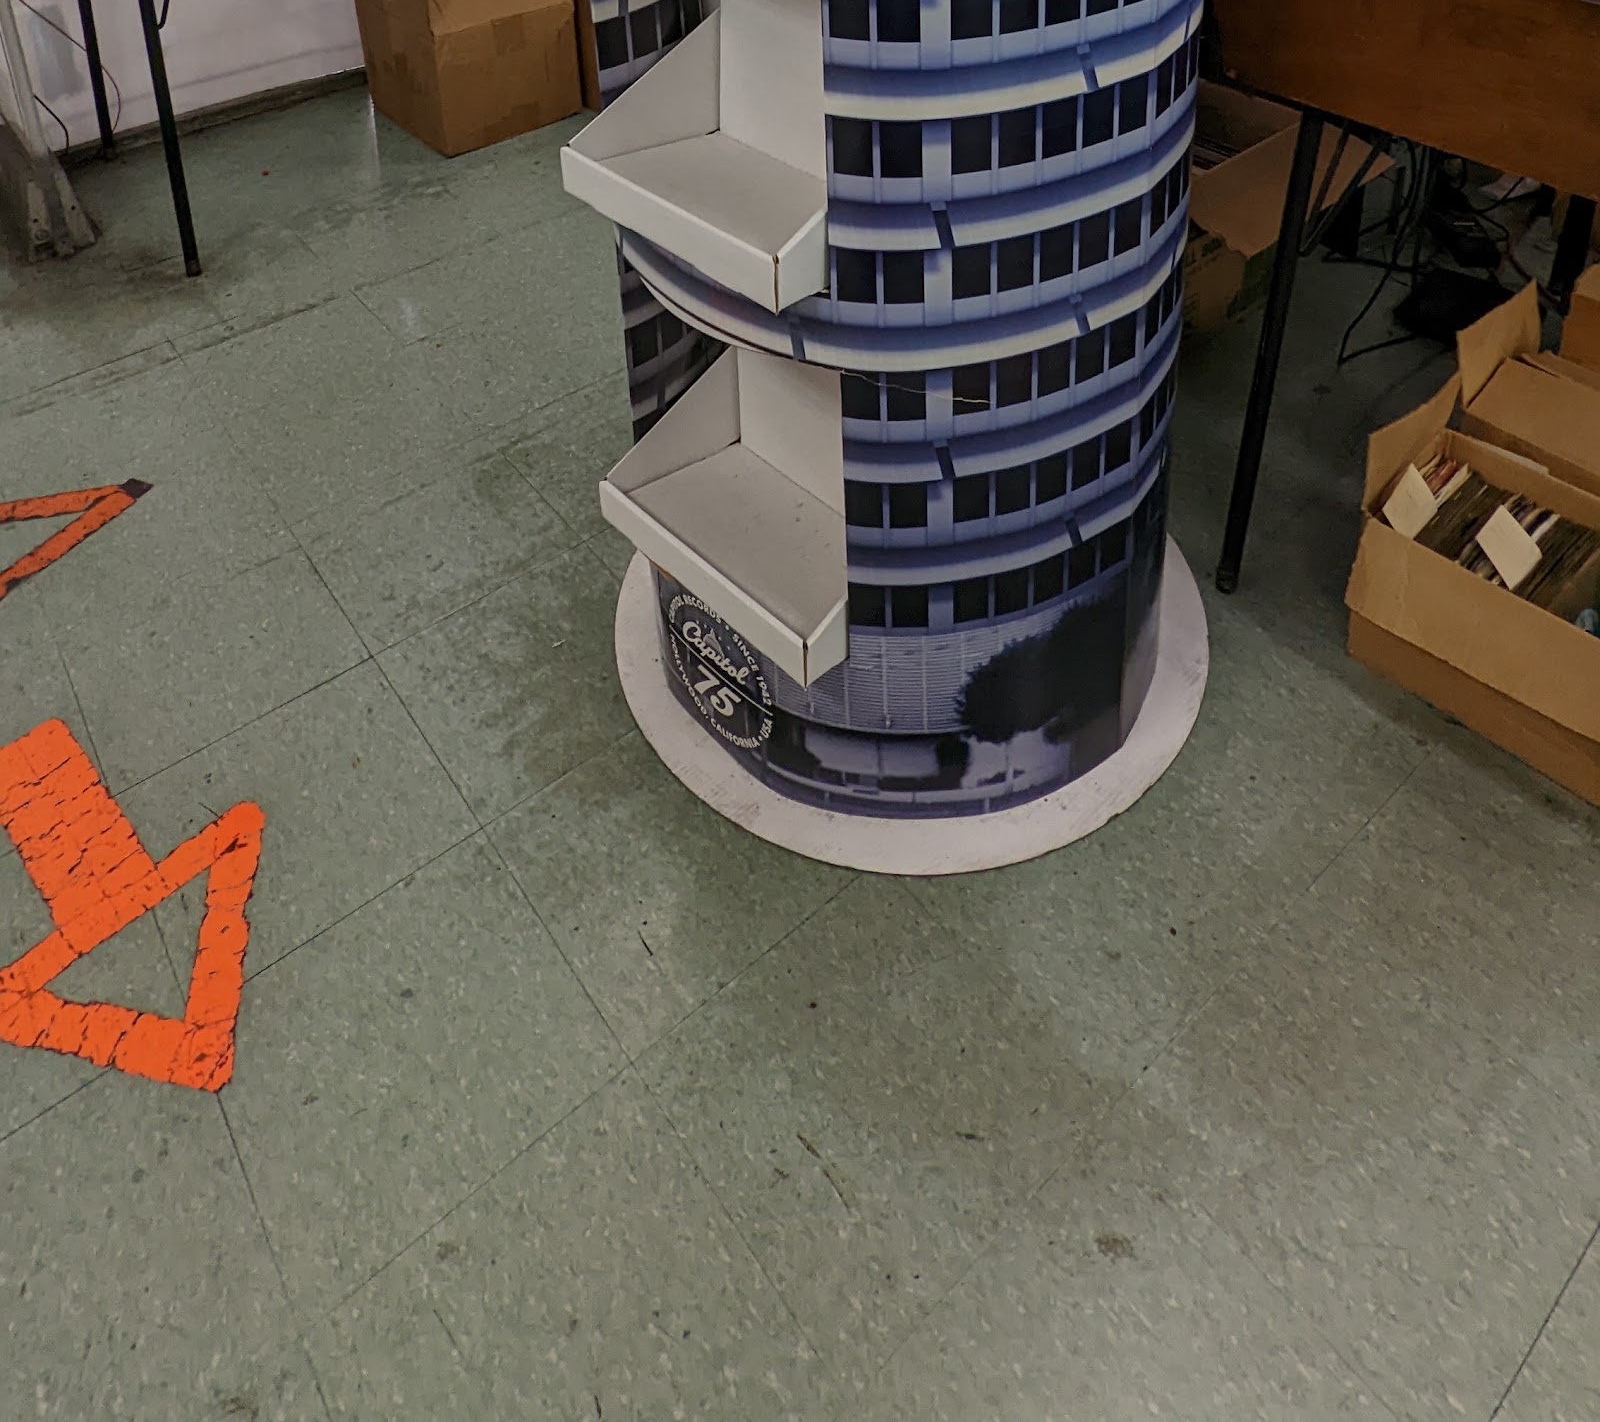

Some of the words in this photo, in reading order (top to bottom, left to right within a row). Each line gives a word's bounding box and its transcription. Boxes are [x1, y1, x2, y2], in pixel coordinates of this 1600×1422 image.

[682, 594, 722, 624] RECORDS
[732, 634, 760, 672] SINCE
[756, 676, 772, 706] 1942
[682, 621, 749, 685] Capitol
[694, 664, 741, 716] 75
[711, 718, 761, 749] CALIFORNIA
[760, 718, 773, 739] USA
